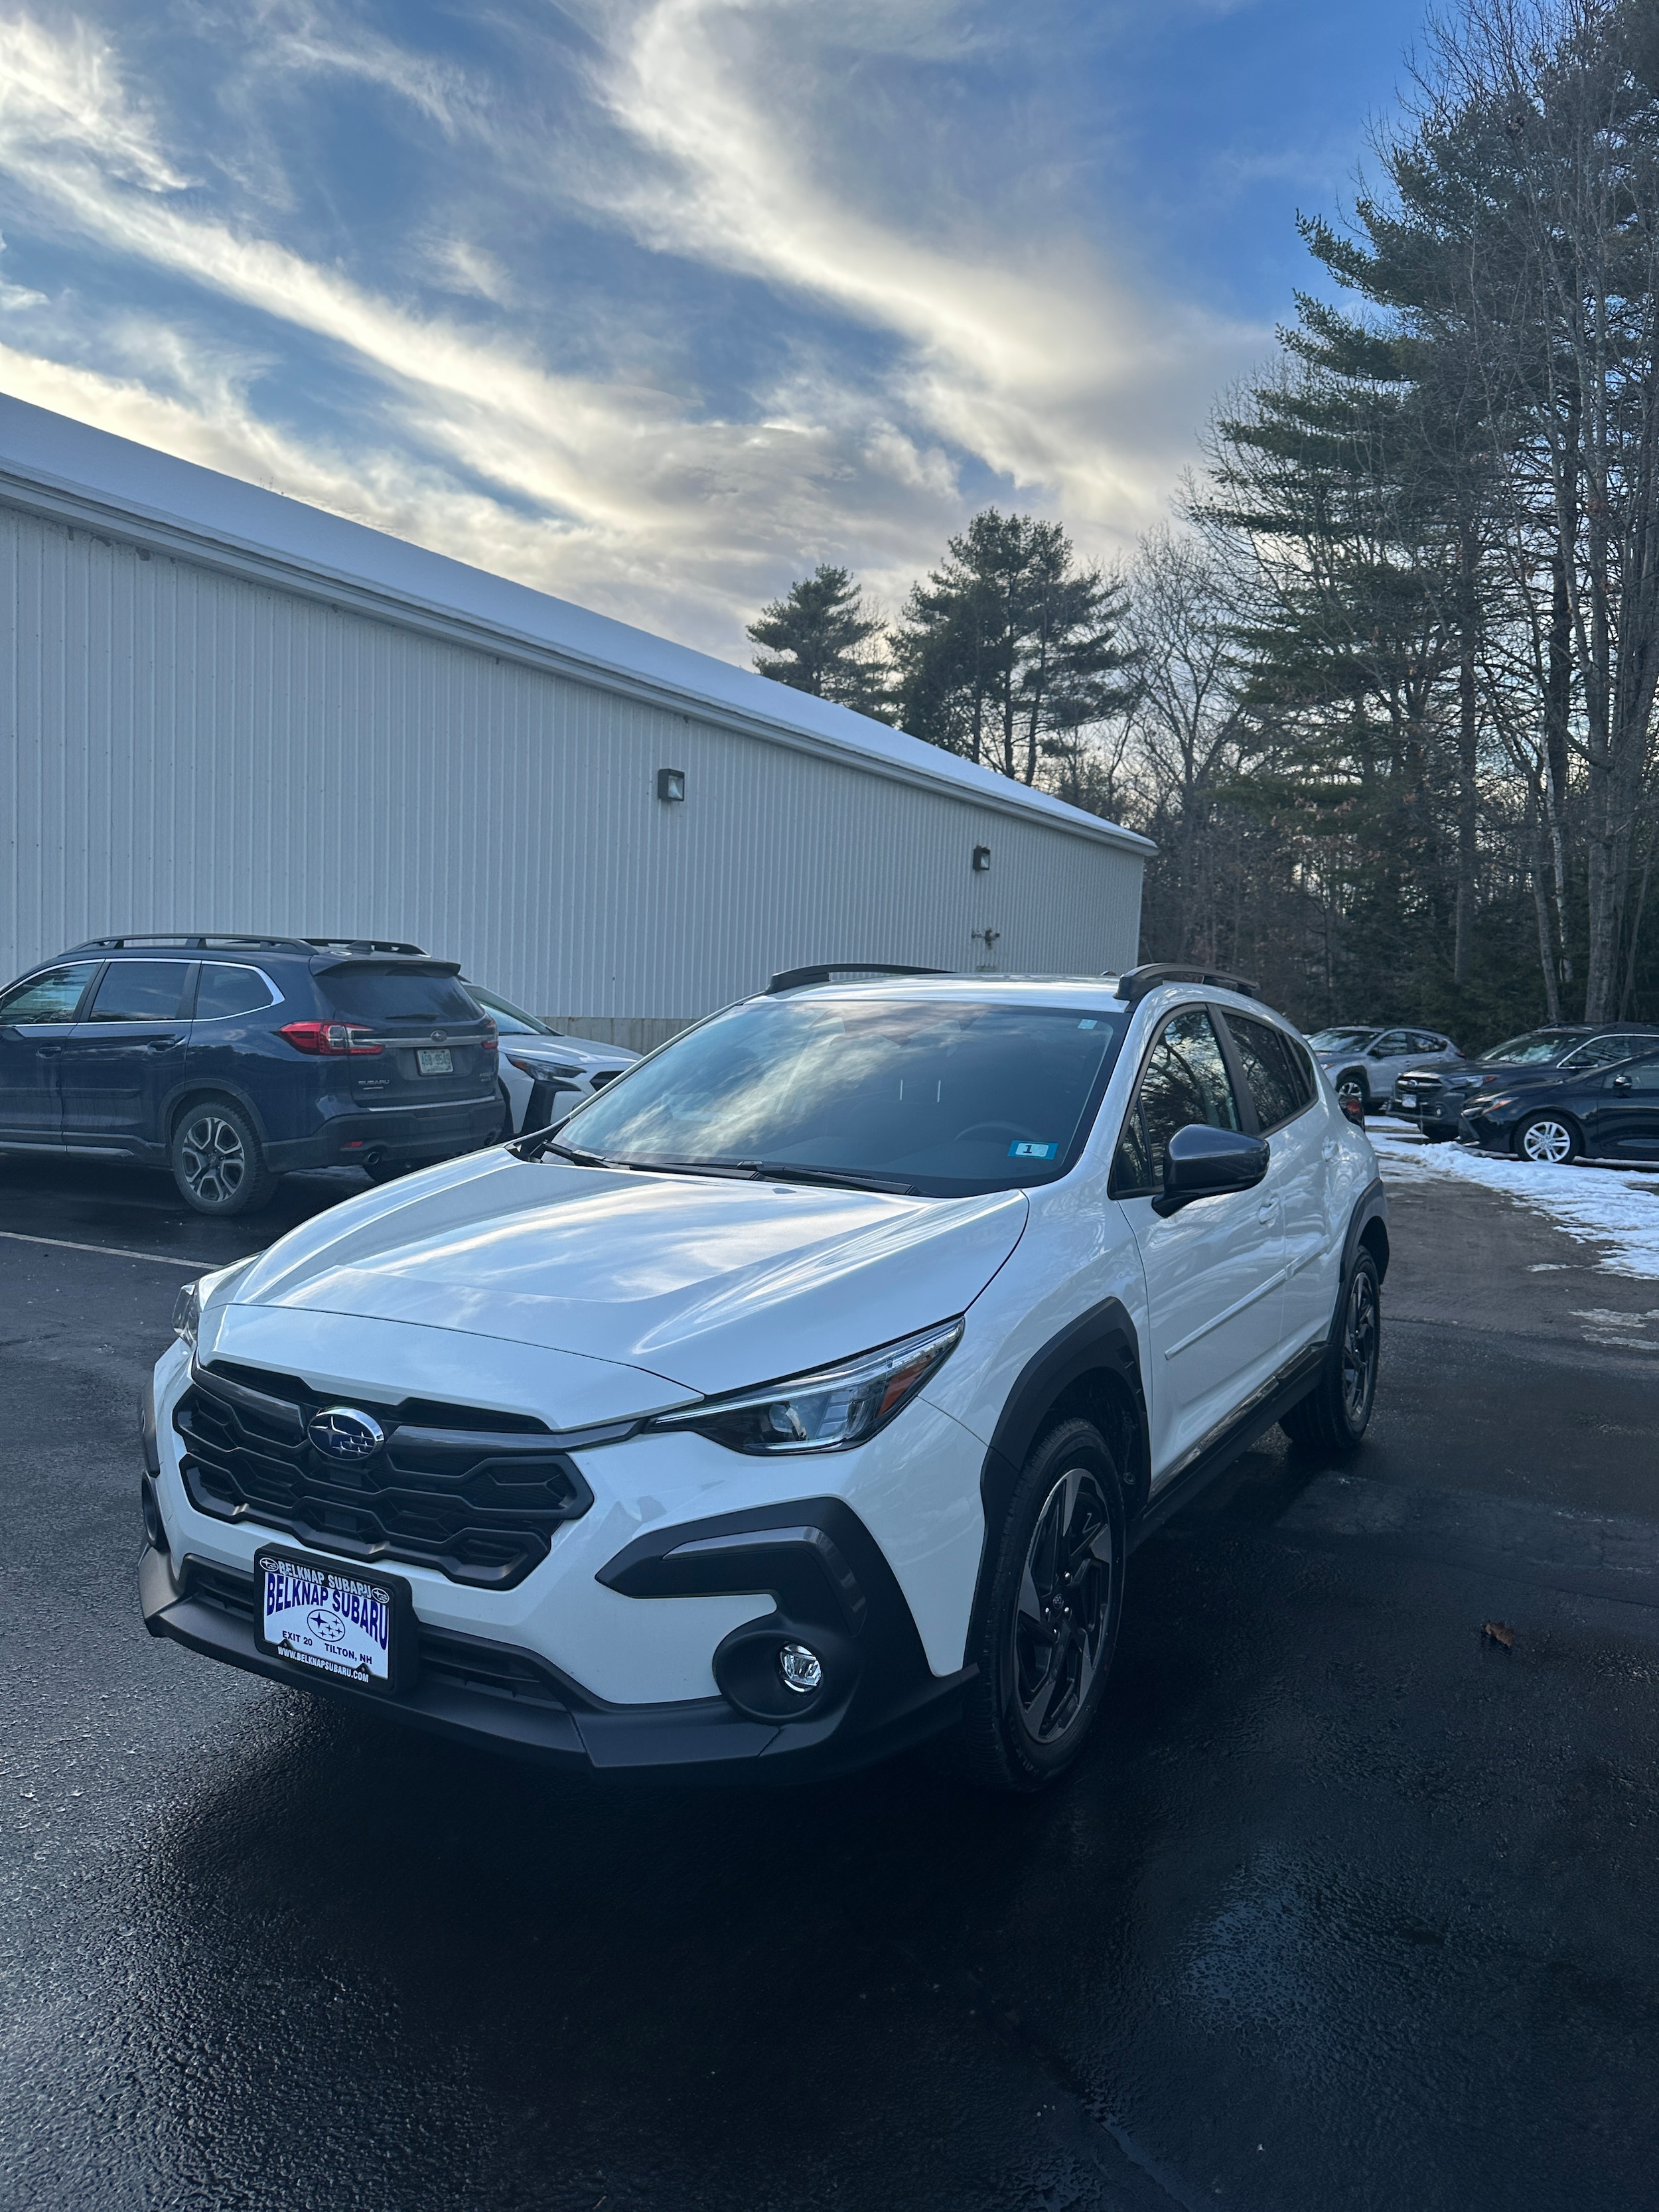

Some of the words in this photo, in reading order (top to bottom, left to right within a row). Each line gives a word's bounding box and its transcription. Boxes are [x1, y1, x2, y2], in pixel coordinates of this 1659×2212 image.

[1023, 1144, 1033, 1153] 1
[277, 1560, 325, 1585] BELKNAP
[327, 1574, 372, 1598] SUBARU
[266, 1572, 328, 1617] BELKNAP
[332, 1589, 388, 1651] SUBARU
[277, 1646, 369, 1683] WWW.BELKNAPSUBARU.COM
[282, 1630, 301, 1643] EXIT
[303, 1637, 313, 1647] 20
[325, 1643, 358, 1662] TILTON,
[360, 1653, 372, 1664] NH
